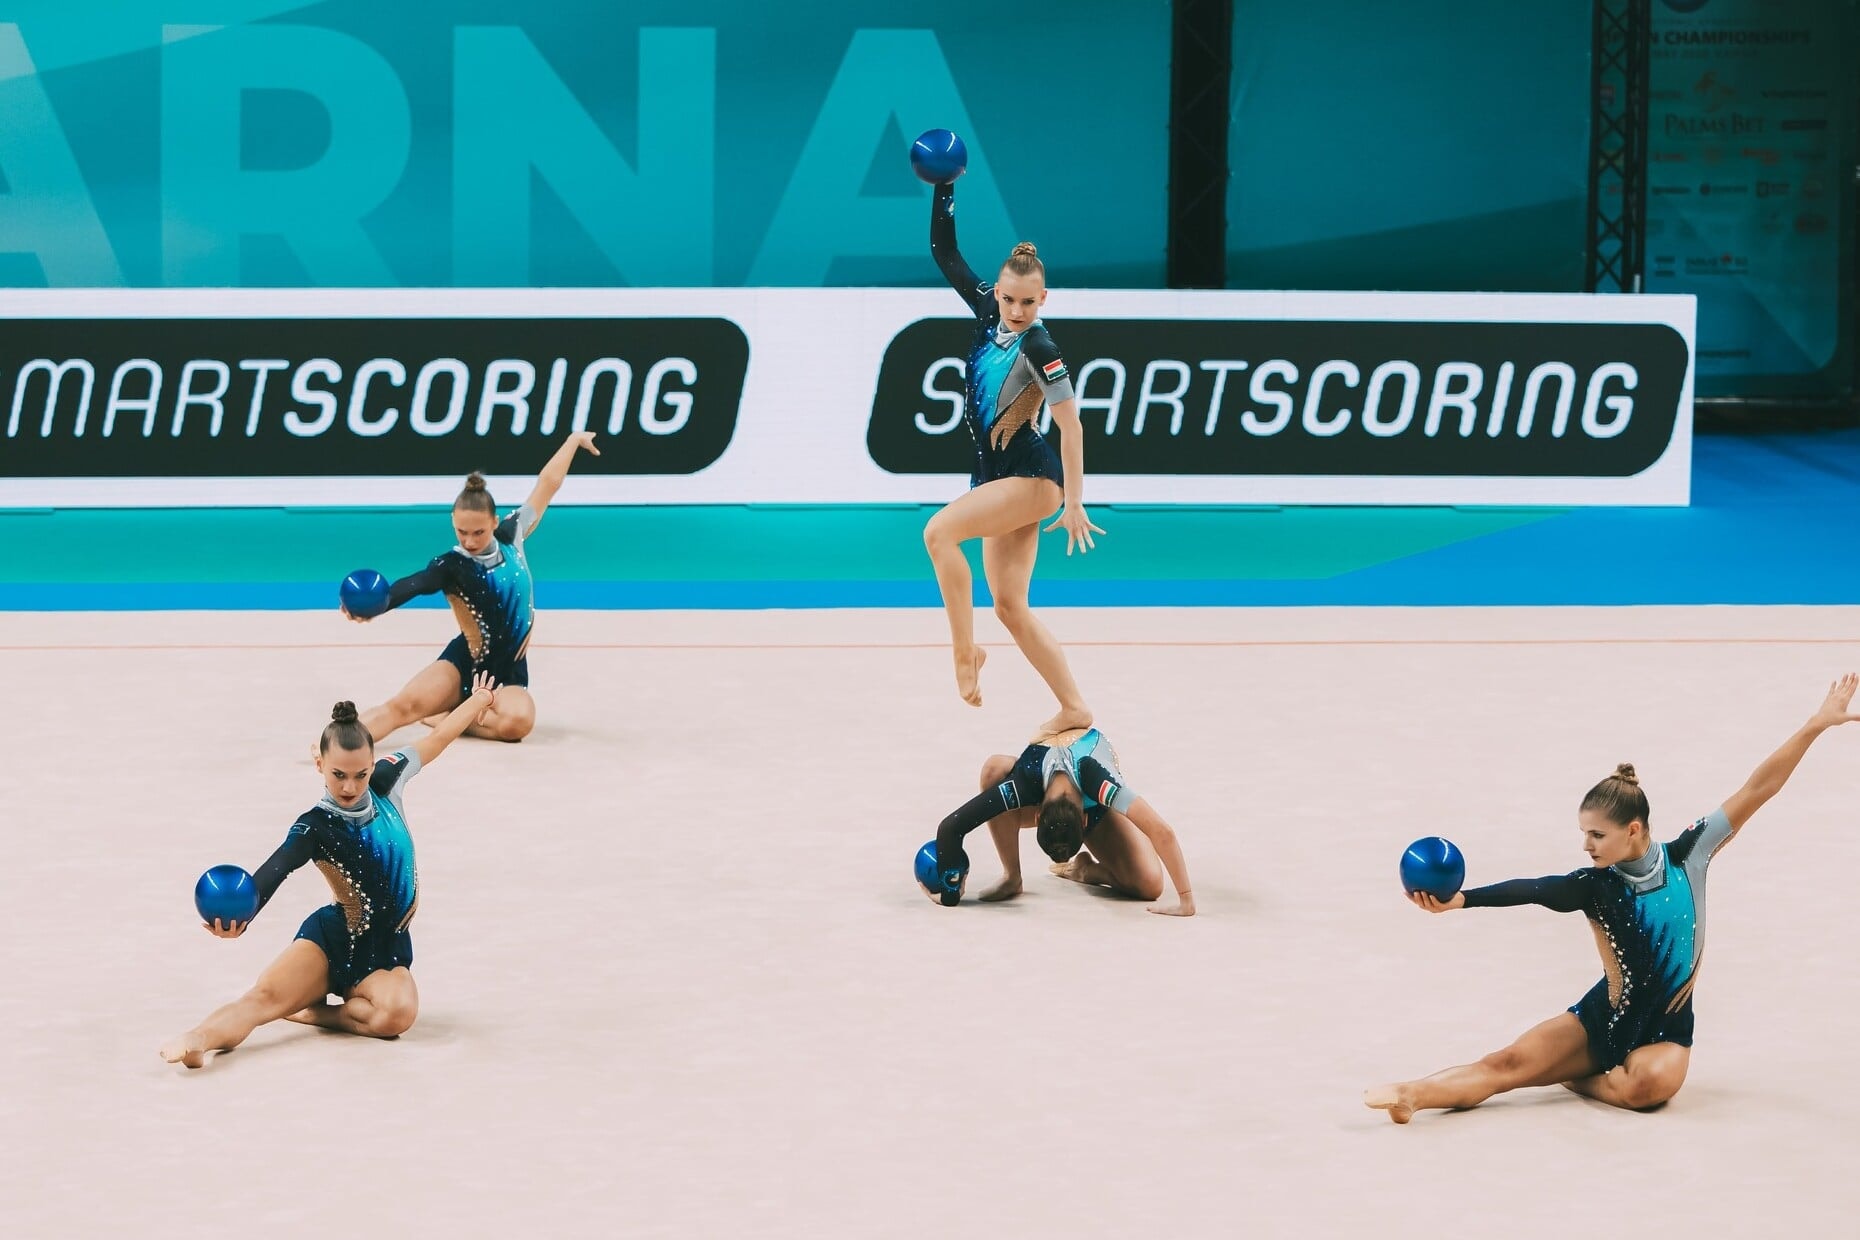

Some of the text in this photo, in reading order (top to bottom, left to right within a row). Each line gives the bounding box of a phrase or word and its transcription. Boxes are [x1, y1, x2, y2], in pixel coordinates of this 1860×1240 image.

[1664, 29, 1811, 45] CHAMPIONSHIPS
[0, 357, 698, 437] MARTSCORING
[914, 357, 1639, 439] SARTSCORING
